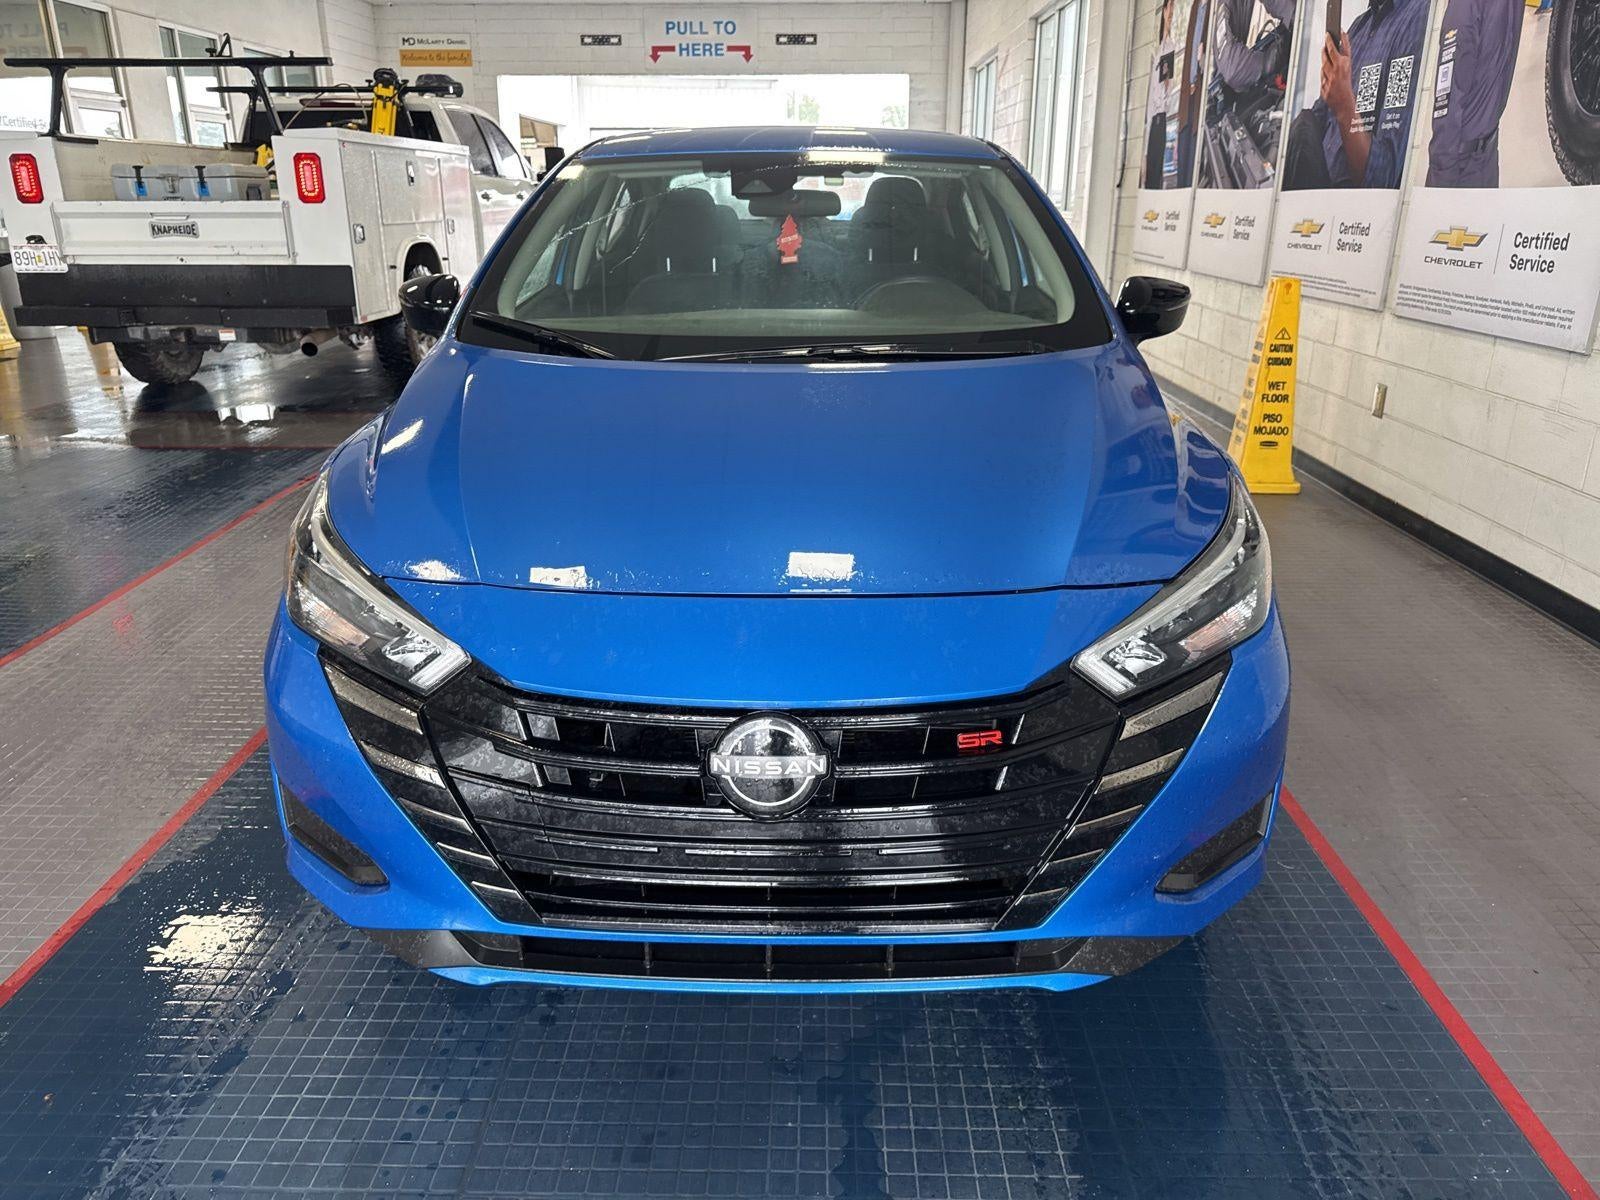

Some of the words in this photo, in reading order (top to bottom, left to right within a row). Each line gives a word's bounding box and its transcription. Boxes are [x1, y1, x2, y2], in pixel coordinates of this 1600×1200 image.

[665, 21, 709, 35] PULL
[713, 21, 737, 35] TO
[678, 43, 725, 57] HERE
[1234, 216, 1256, 228] Certified
[150, 223, 198, 236] KNAPHEIDE
[1232, 228, 1250, 241] Service
[1338, 222, 1371, 237] Certified
[1286, 242, 1322, 251] CHEVROLET
[1336, 238, 1363, 253] Service
[1514, 232, 1571, 251] Certified
[1424, 255, 1483, 270] CHEVROLET
[1509, 253, 1555, 274] Service
[1269, 344, 1293, 353] CAUTION
[1267, 357, 1292, 366] CUIDADO
[1268, 381, 1287, 391] WET
[1261, 393, 1289, 403] FLOOR
[1262, 413, 1282, 423] PISO
[1253, 425, 1289, 436] MOJADO
[957, 730, 1003, 749] SR
[711, 756, 827, 776] NISSAN
